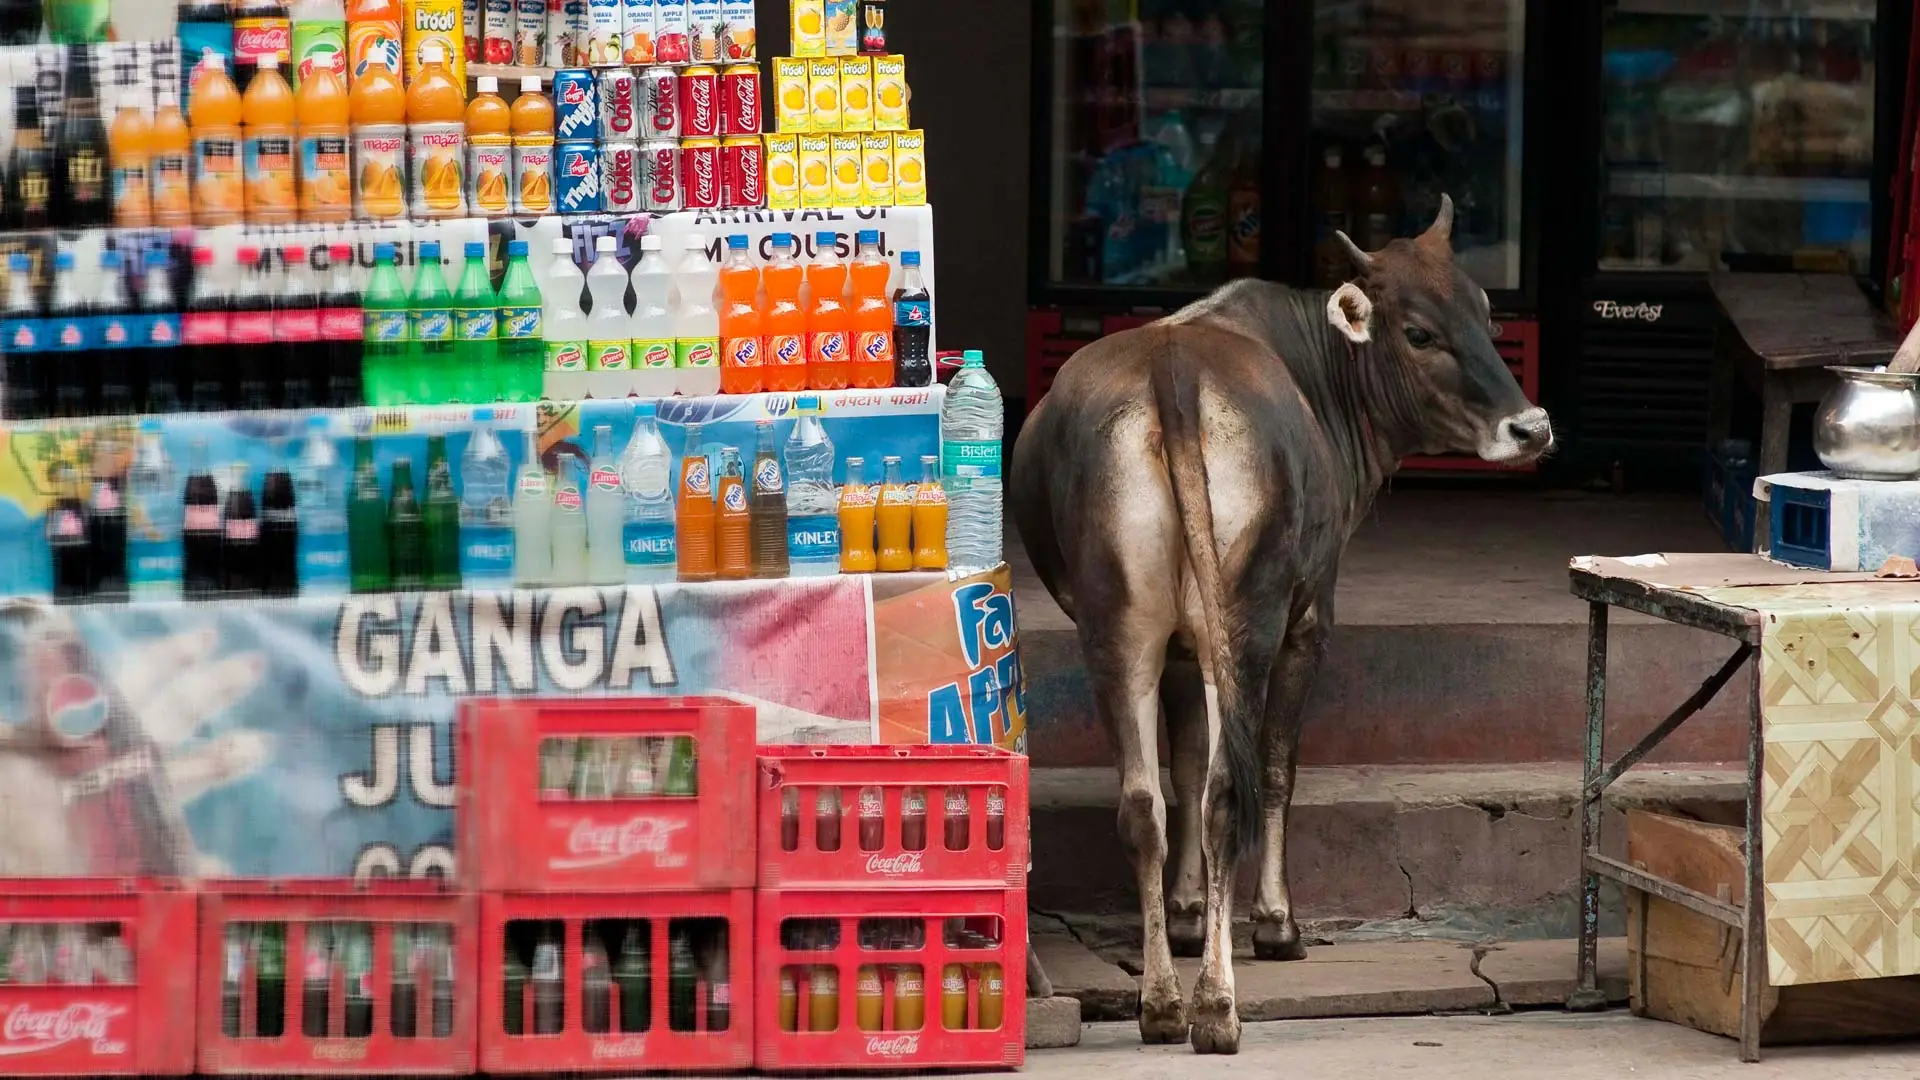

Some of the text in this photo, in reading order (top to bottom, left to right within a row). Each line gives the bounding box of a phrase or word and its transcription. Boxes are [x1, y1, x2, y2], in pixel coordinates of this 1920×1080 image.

[415, 8, 455, 31] Frooti
[238, 29, 288, 49] Coca-Cola
[611, 77, 633, 133] Coke
[652, 75, 675, 131] Coke
[692, 77, 711, 132] Coca-Cola
[737, 75, 756, 131] Coca-Cola
[364, 137, 401, 152] maaza
[423, 133, 460, 147] maaza
[478, 153, 506, 165] maaza
[522, 154, 550, 165] maaza
[611, 150, 633, 204] Coke
[652, 149, 675, 203] Coke
[694, 149, 714, 204] Coca-Cola
[741, 147, 759, 202] Coca-Cola
[1593, 300, 1663, 322] Everest
[630, 538, 675, 553] KINLEY
[794, 530, 839, 545] KINLEY
[951, 583, 1018, 669] Fa
[335, 586, 679, 698] GANGA
[865, 852, 924, 874] Coca-Cola
[4, 1003, 127, 1041] Coca-Cola
[866, 1034, 920, 1056] Coca-Cola
